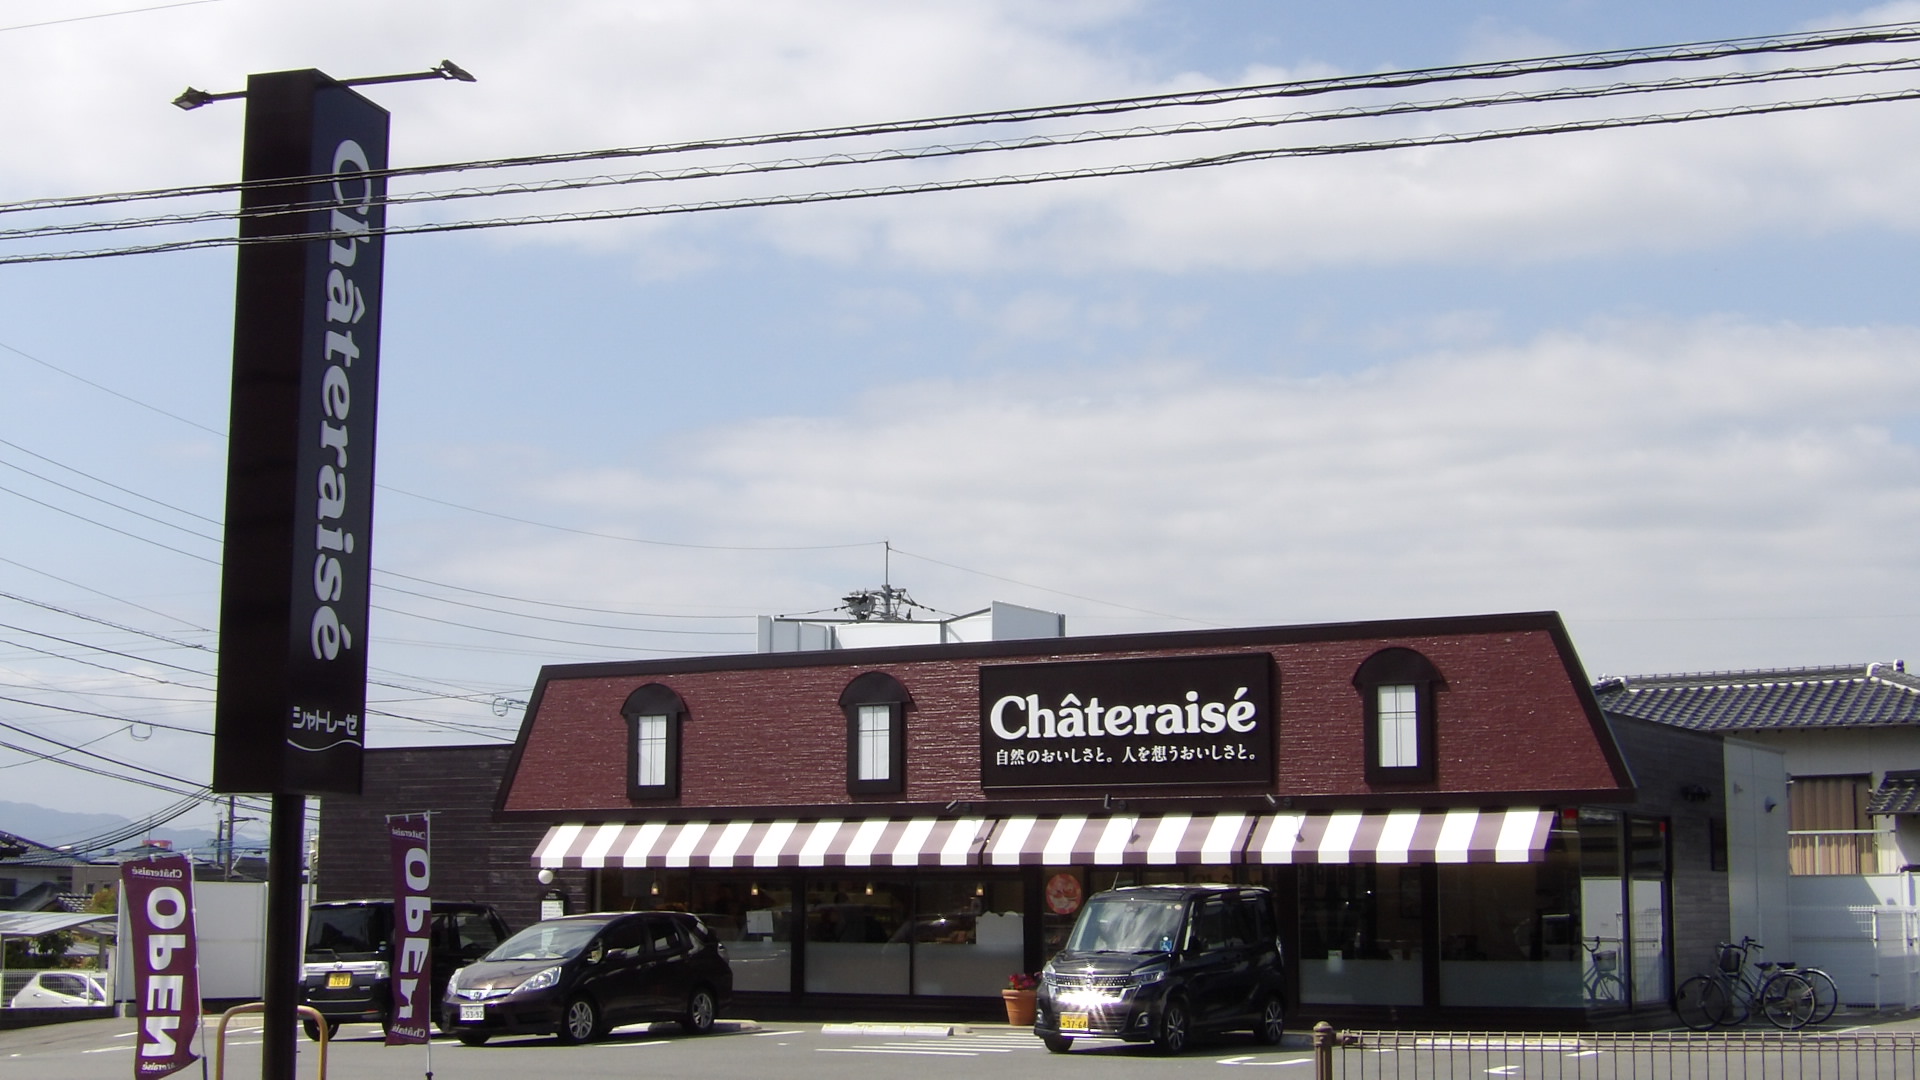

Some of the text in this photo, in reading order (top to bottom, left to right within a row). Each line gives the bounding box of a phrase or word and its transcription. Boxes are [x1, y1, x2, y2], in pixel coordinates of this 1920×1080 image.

[309, 139, 372, 662] Châteraisé
[292, 705, 358, 736] シャトレーゼ
[990, 686, 1257, 740] Châteraisé
